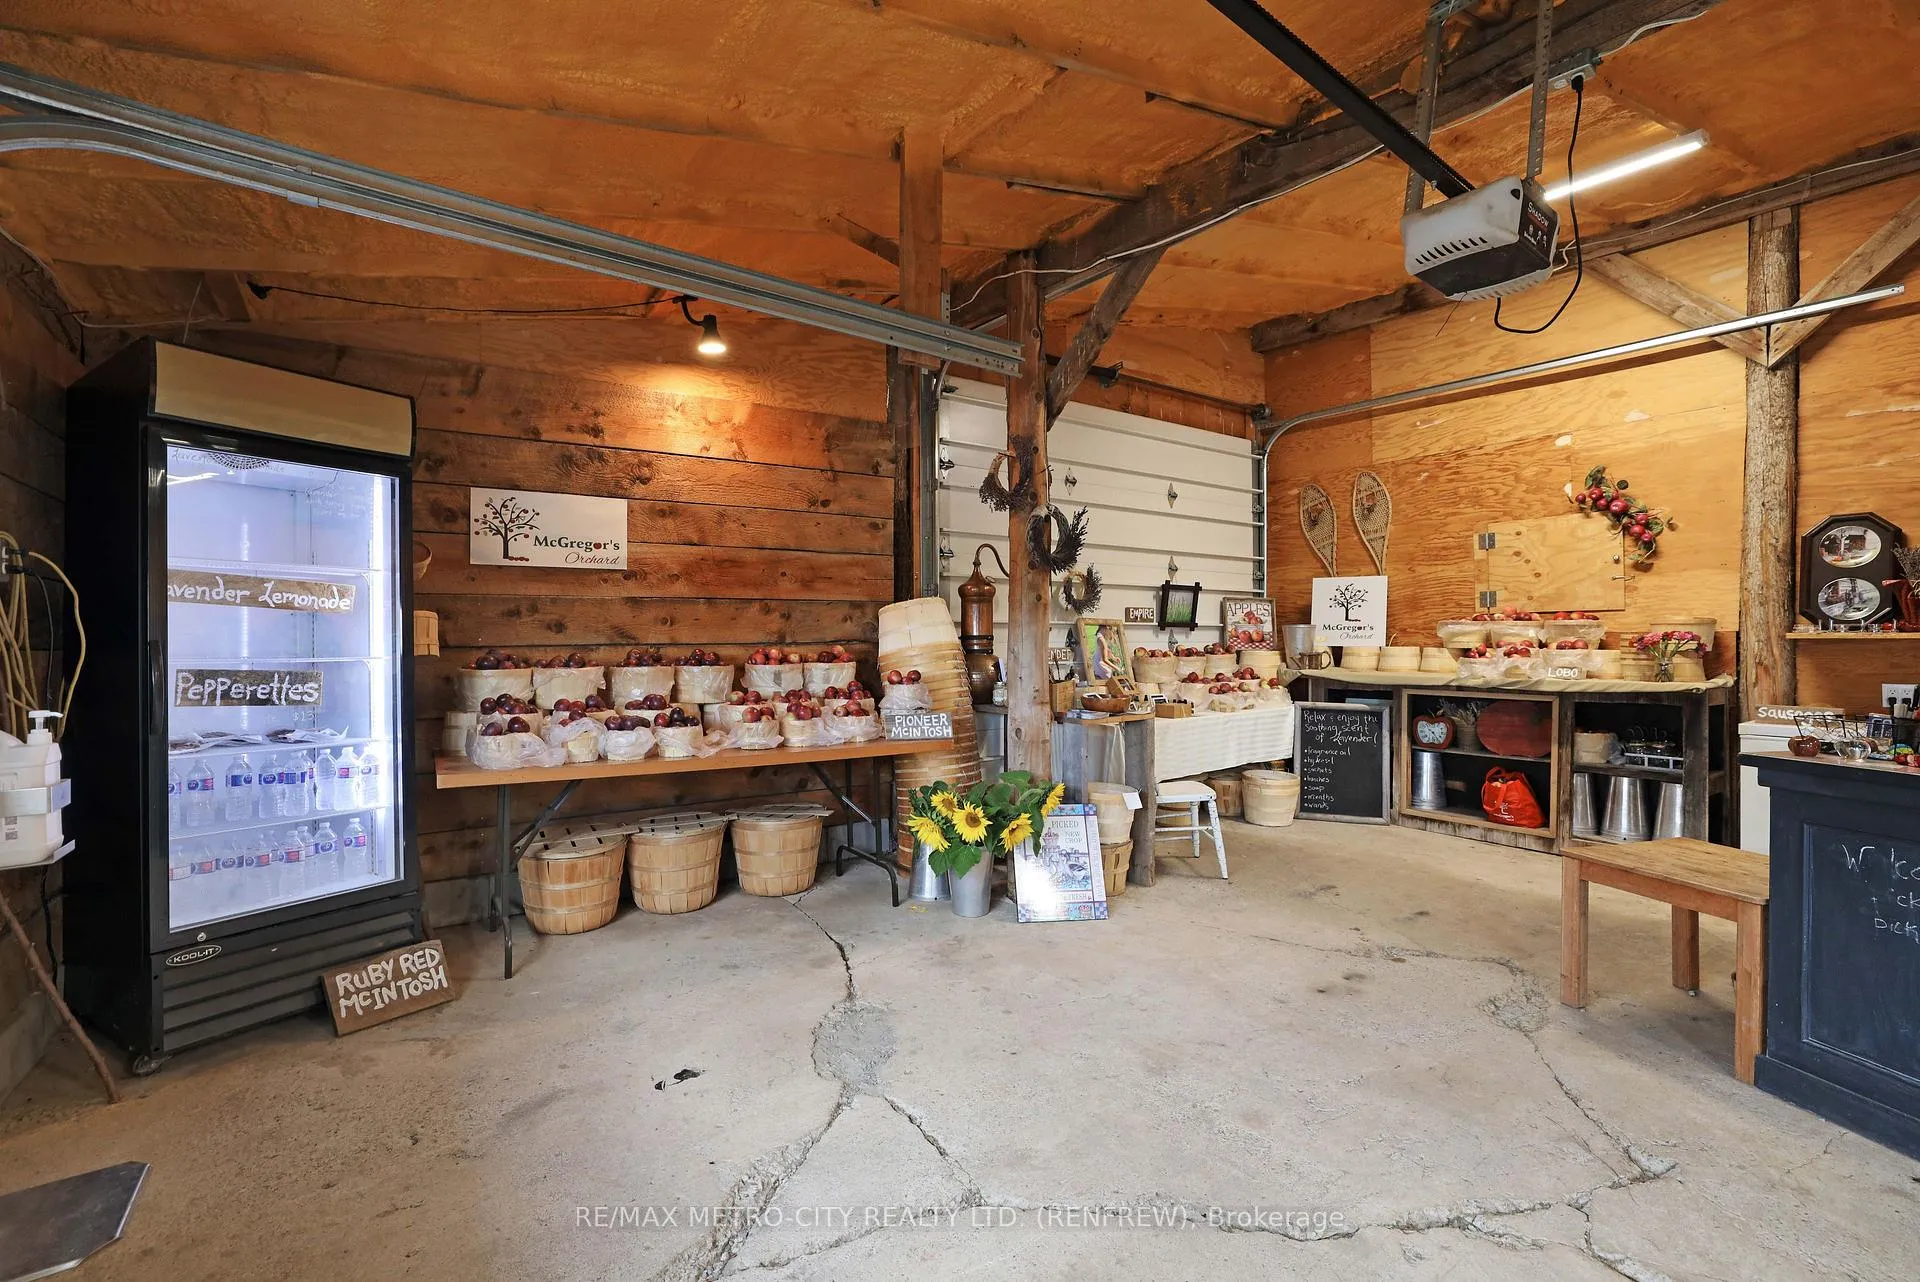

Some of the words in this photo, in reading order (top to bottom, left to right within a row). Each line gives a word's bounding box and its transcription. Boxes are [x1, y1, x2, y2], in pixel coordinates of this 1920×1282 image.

[533, 535, 620, 552] McGregor's
[564, 551, 620, 565] Orchard
[167, 576, 250, 604] avender
[258, 581, 352, 609] Lemonade
[1129, 608, 1154, 621] EMPIRE
[1226, 602, 1271, 617] APPLES
[1321, 623, 1375, 633] McGregor's
[1339, 632, 1375, 640] Orchard
[1547, 667, 1578, 678] LOBO
[176, 671, 319, 706] Pepperettes
[895, 713, 949, 727] PIONEER
[1303, 710, 1326, 723] Relax
[1337, 714, 1360, 727] enjoy
[1341, 724, 1370, 735] scent
[1315, 732, 1325, 743] of
[1051, 820, 1079, 829] PICKED
[335, 958, 394, 996] RUBY
[399, 948, 441, 976] RED
